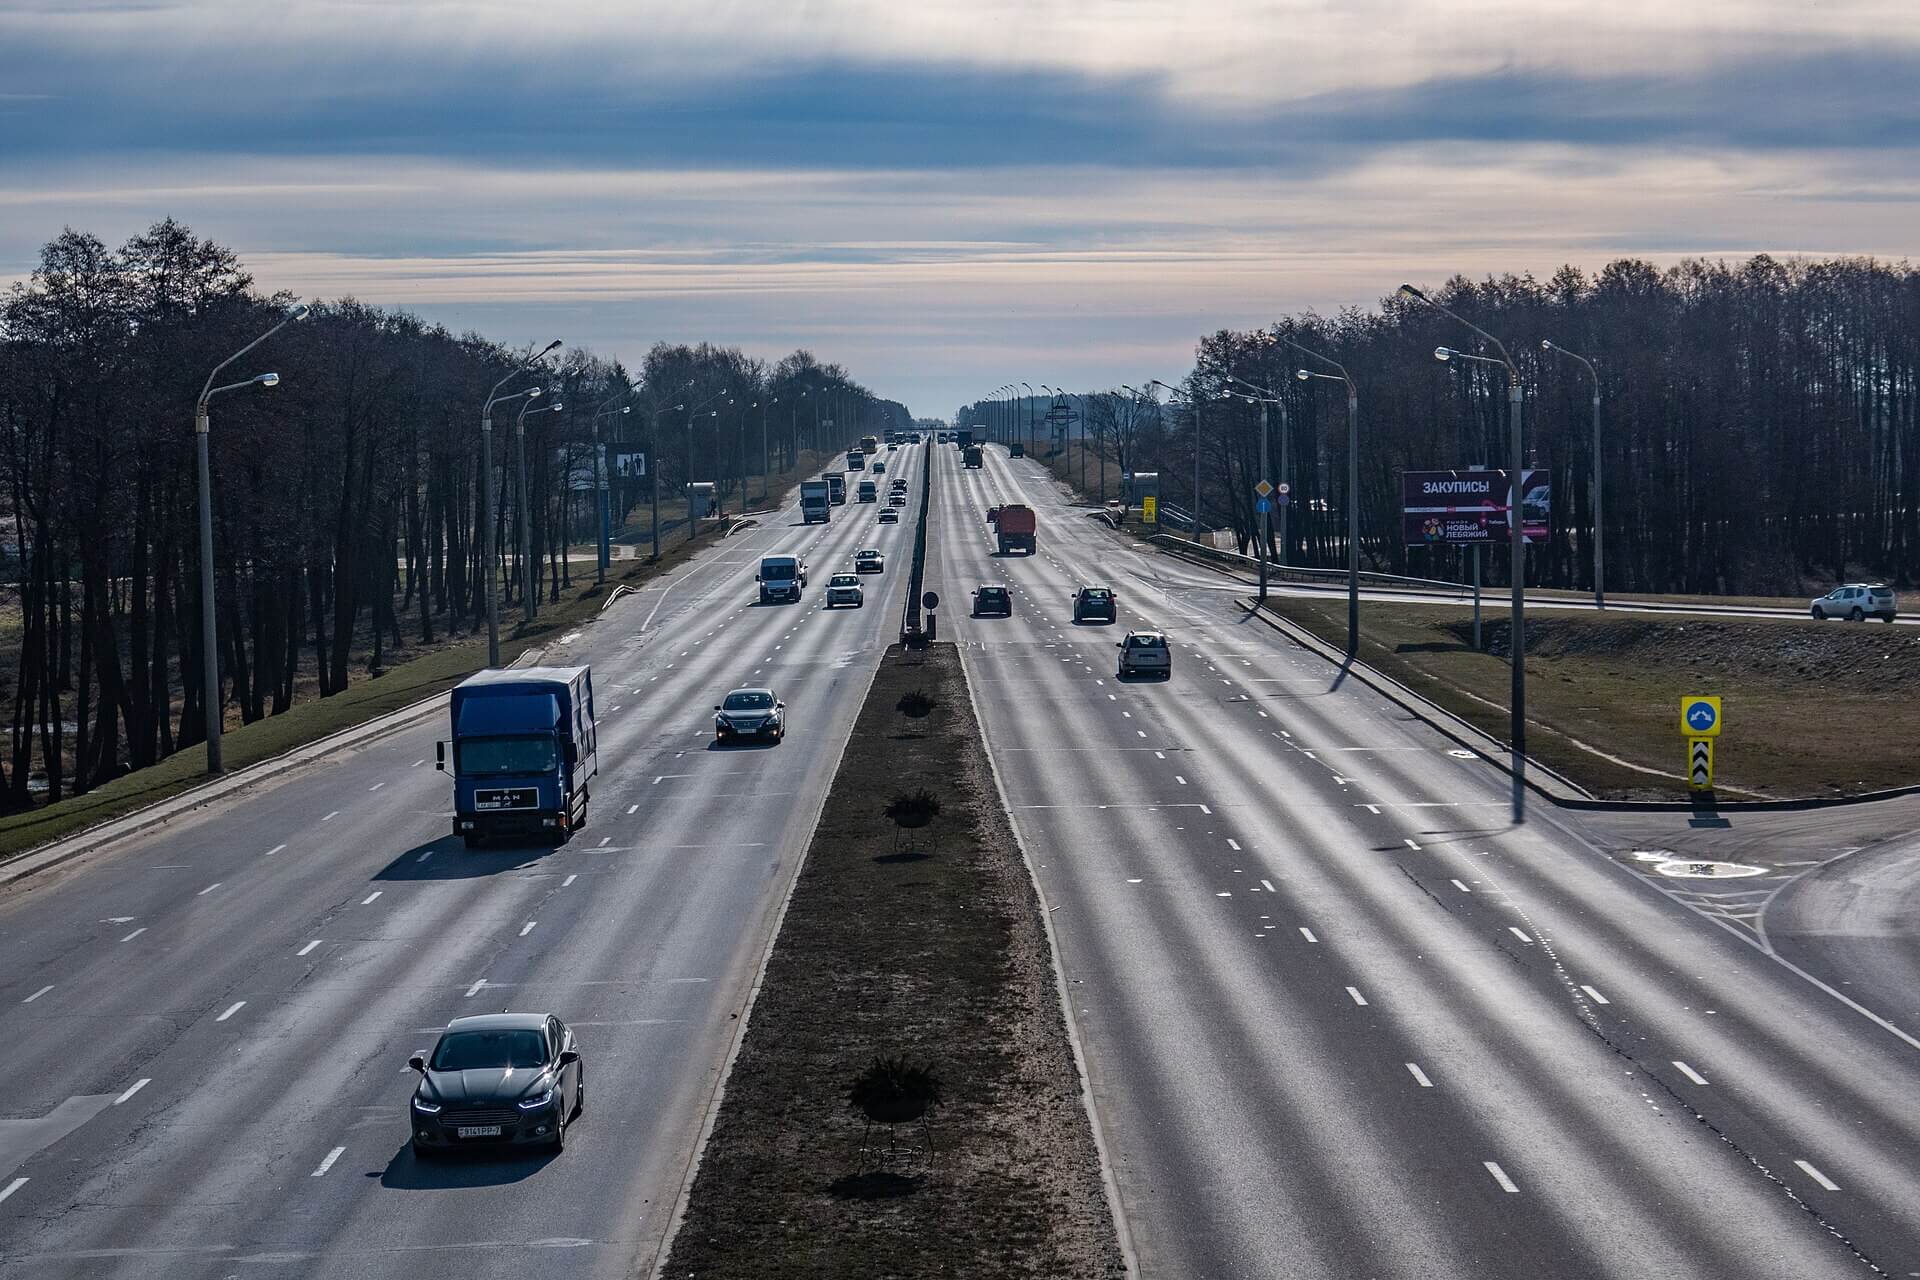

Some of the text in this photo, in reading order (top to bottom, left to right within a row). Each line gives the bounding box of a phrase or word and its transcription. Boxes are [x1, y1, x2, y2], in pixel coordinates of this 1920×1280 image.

[1423, 481, 1490, 494] ЗАКУПИСЬ!
[1446, 523, 1479, 531] НОВЫЙ
[1446, 530, 1488, 538] ЛЕБЯЖИЙ
